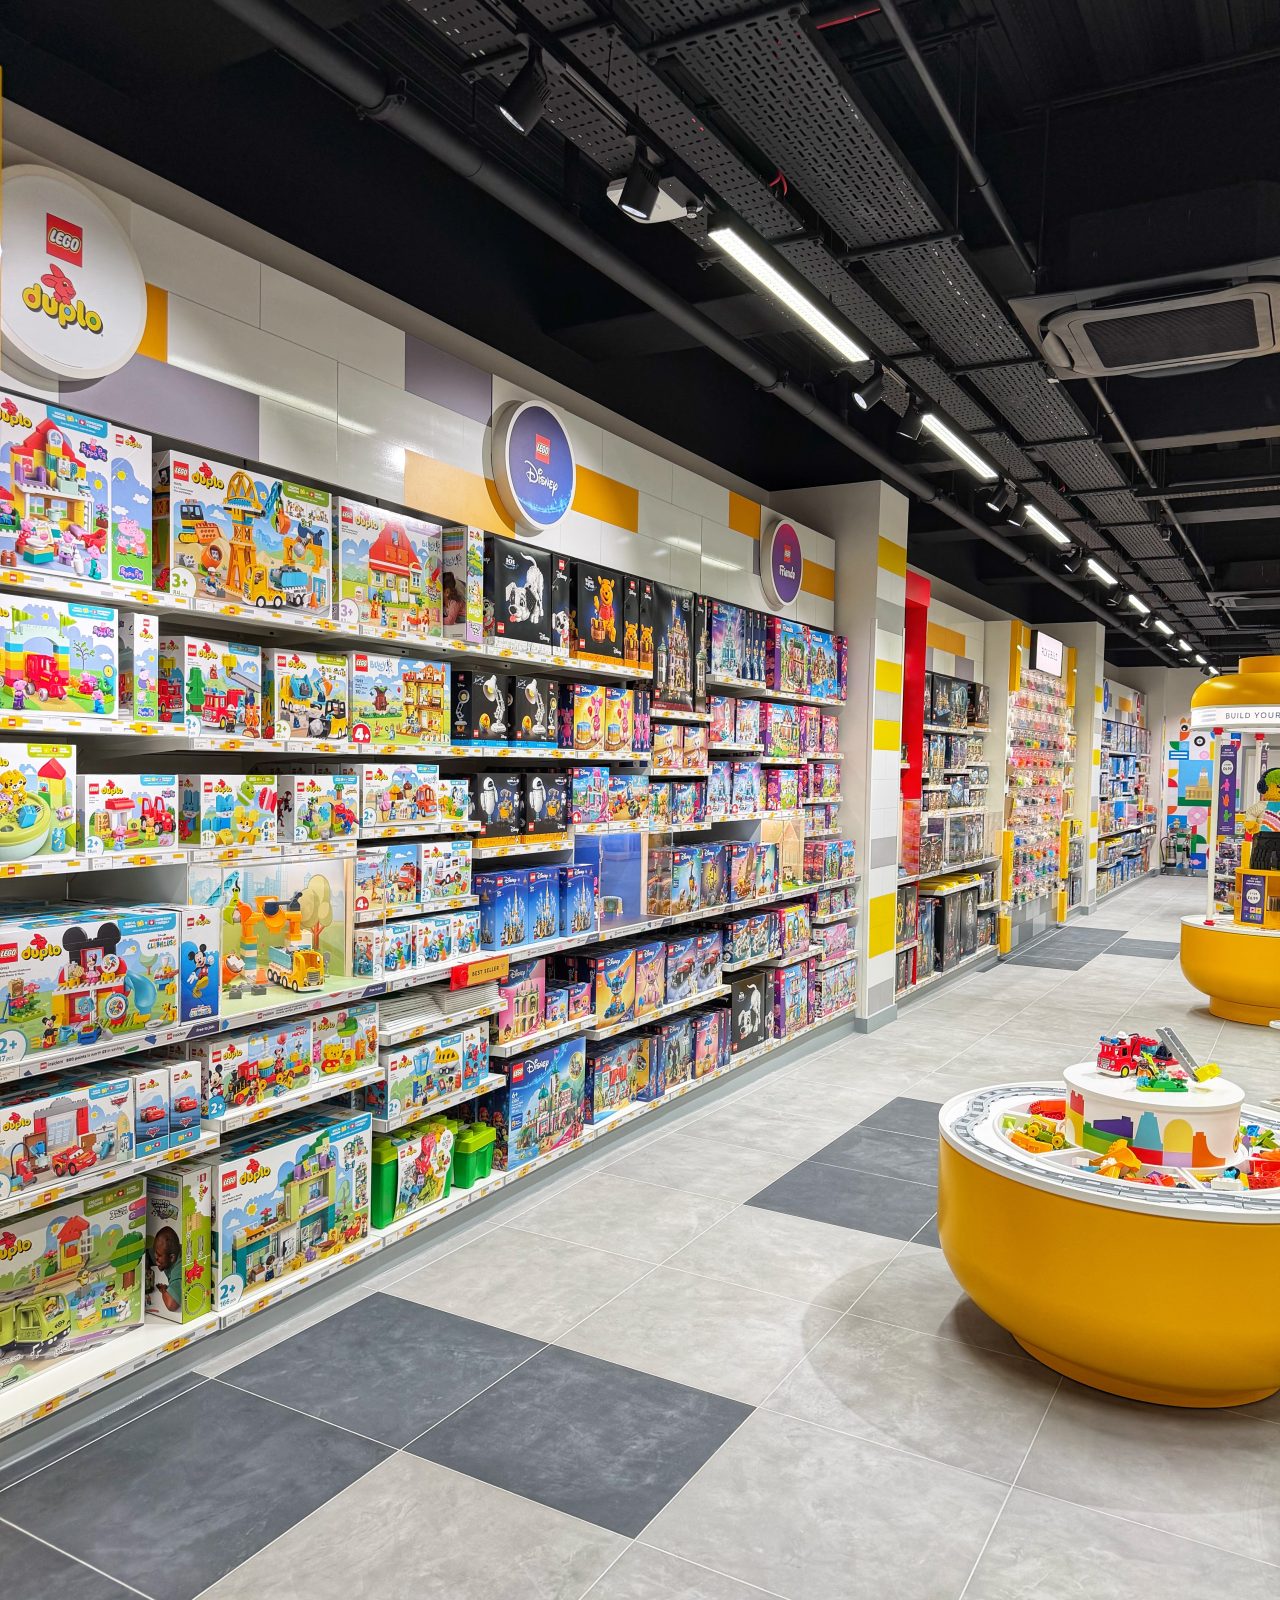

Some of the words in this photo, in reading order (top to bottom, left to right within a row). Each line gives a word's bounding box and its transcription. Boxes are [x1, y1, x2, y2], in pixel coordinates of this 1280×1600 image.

[48, 227, 81, 254] LEGO
[22, 283, 103, 334] duplo
[0, 408, 32, 428] uplo
[536, 443, 550, 456] LEGO
[174, 466, 188, 476] LEGO
[191, 472, 224, 490] duplo
[354, 514, 378, 530] duplo
[779, 564, 796, 580] Friends
[172, 573, 188, 588] 3+
[340, 604, 353, 616] 3+
[198, 650, 218, 660] duplo
[288, 660, 307, 670] duplo
[187, 718, 196, 728] 2+
[276, 723, 288, 732] 2+
[355, 728, 370, 740] 4+
[101, 786, 124, 796] duplo
[306, 784, 322, 793] duplo
[364, 812, 374, 820] 2+
[295, 828, 304, 836] 2+
[87, 838, 99, 848] 2+
[356, 900, 368, 910] 4+
[0, 949, 17, 958] LEGO
[21, 944, 62, 961] duplo
[484, 966, 500, 974] SELLER
[0, 1038, 18, 1054] 2+
[223, 1050, 242, 1060] duplo
[525, 1058, 550, 1074] Disney
[513, 1068, 524, 1078] LEGO
[211, 1102, 223, 1114] 2+
[388, 1103, 398, 1113] 2+
[3, 1118, 32, 1132] duplo
[224, 1176, 236, 1186] LEGO
[240, 1166, 271, 1185] duplo
[0, 1240, 32, 1260] uplo
[220, 1284, 235, 1300] 2+
